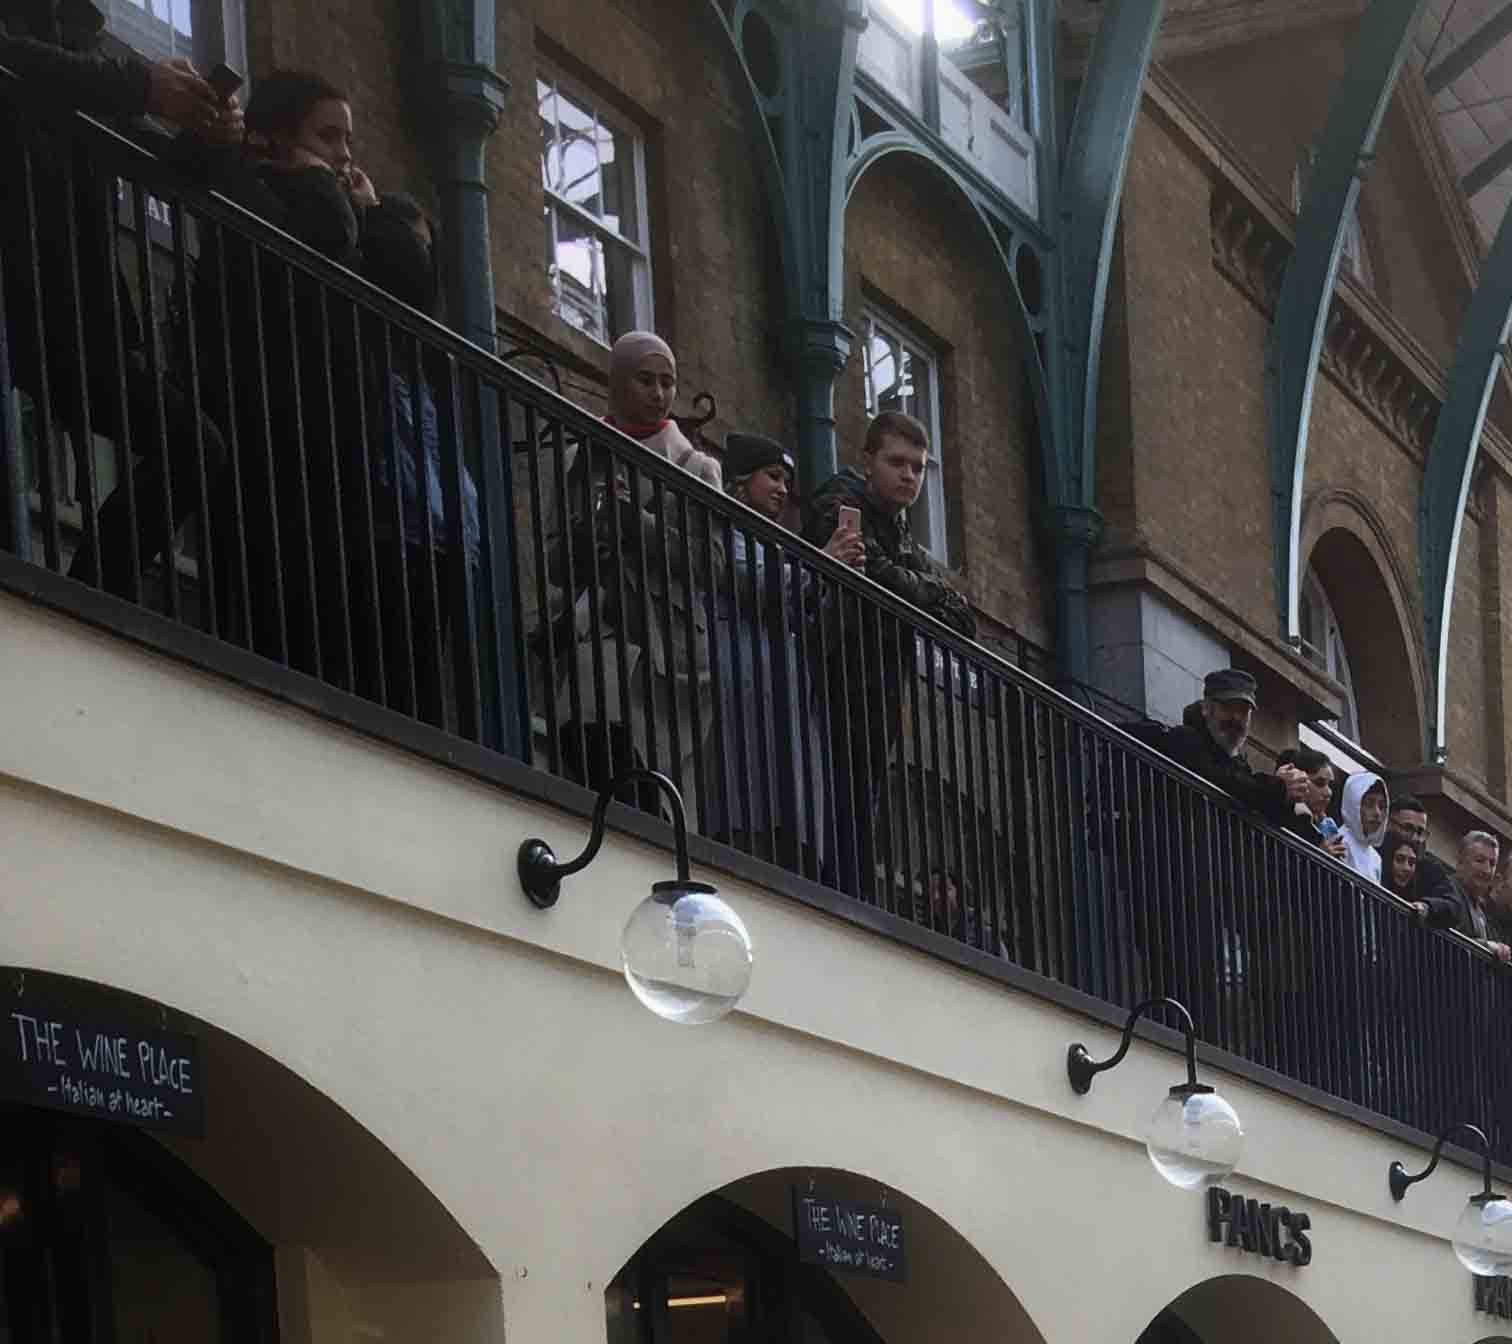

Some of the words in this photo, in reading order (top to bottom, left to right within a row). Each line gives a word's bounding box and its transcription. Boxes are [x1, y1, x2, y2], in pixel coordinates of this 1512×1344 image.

[10, 1012, 67, 1067] THE
[75, 1027, 132, 1080] WINE
[137, 1040, 194, 1094] PLACE
[802, 1198, 832, 1232] THE
